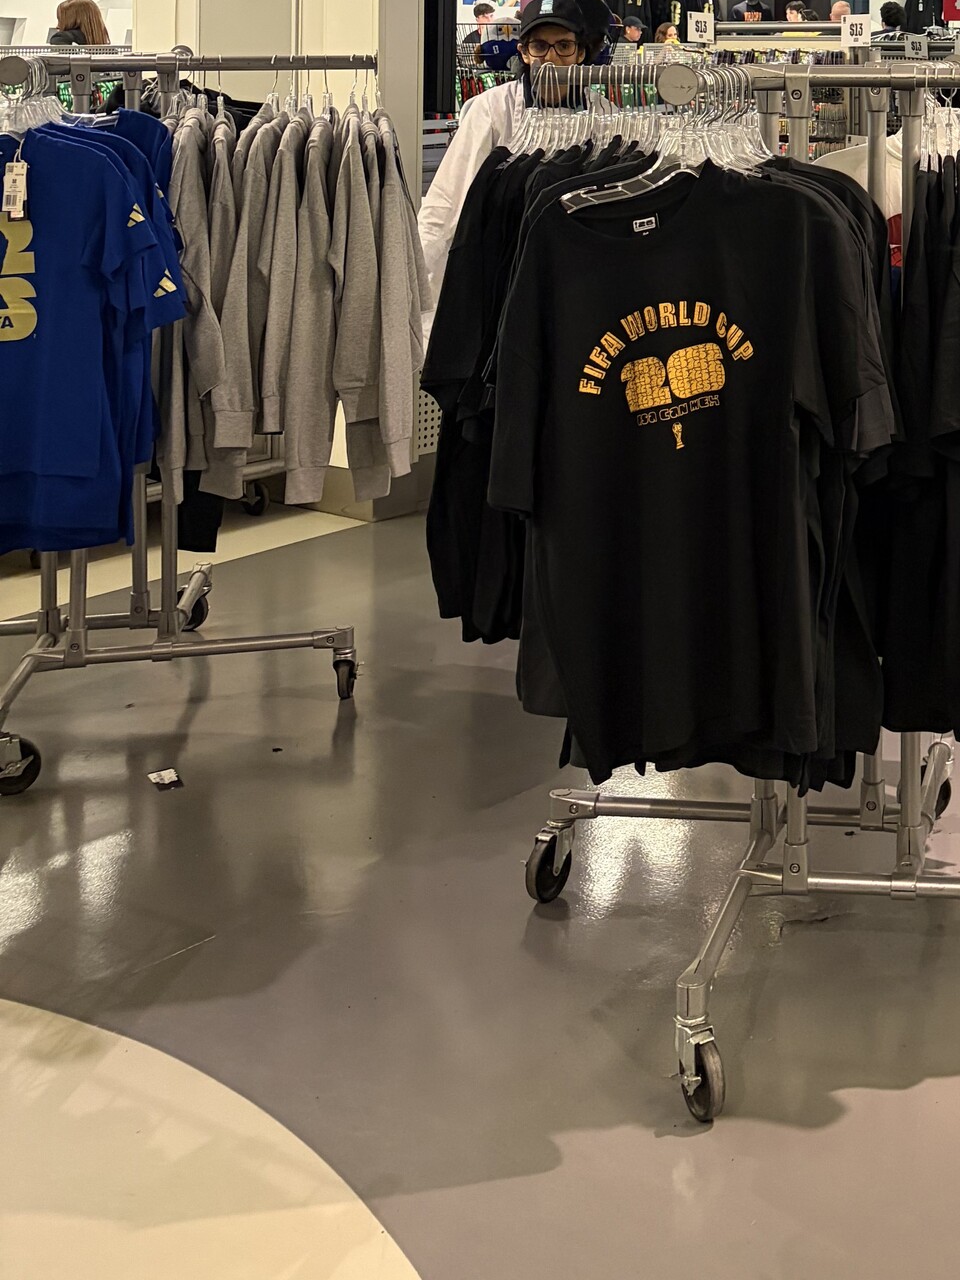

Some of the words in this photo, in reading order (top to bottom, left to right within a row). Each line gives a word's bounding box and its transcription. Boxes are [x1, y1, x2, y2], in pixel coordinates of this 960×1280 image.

[694, 19, 708, 34] $13
[849, 22, 863, 36] $13
[911, 41, 922, 52] $13
[579, 331, 626, 395] FIFA
[620, 301, 711, 342] WORLD
[716, 312, 754, 361] CUP
[620, 342, 726, 413] 26
